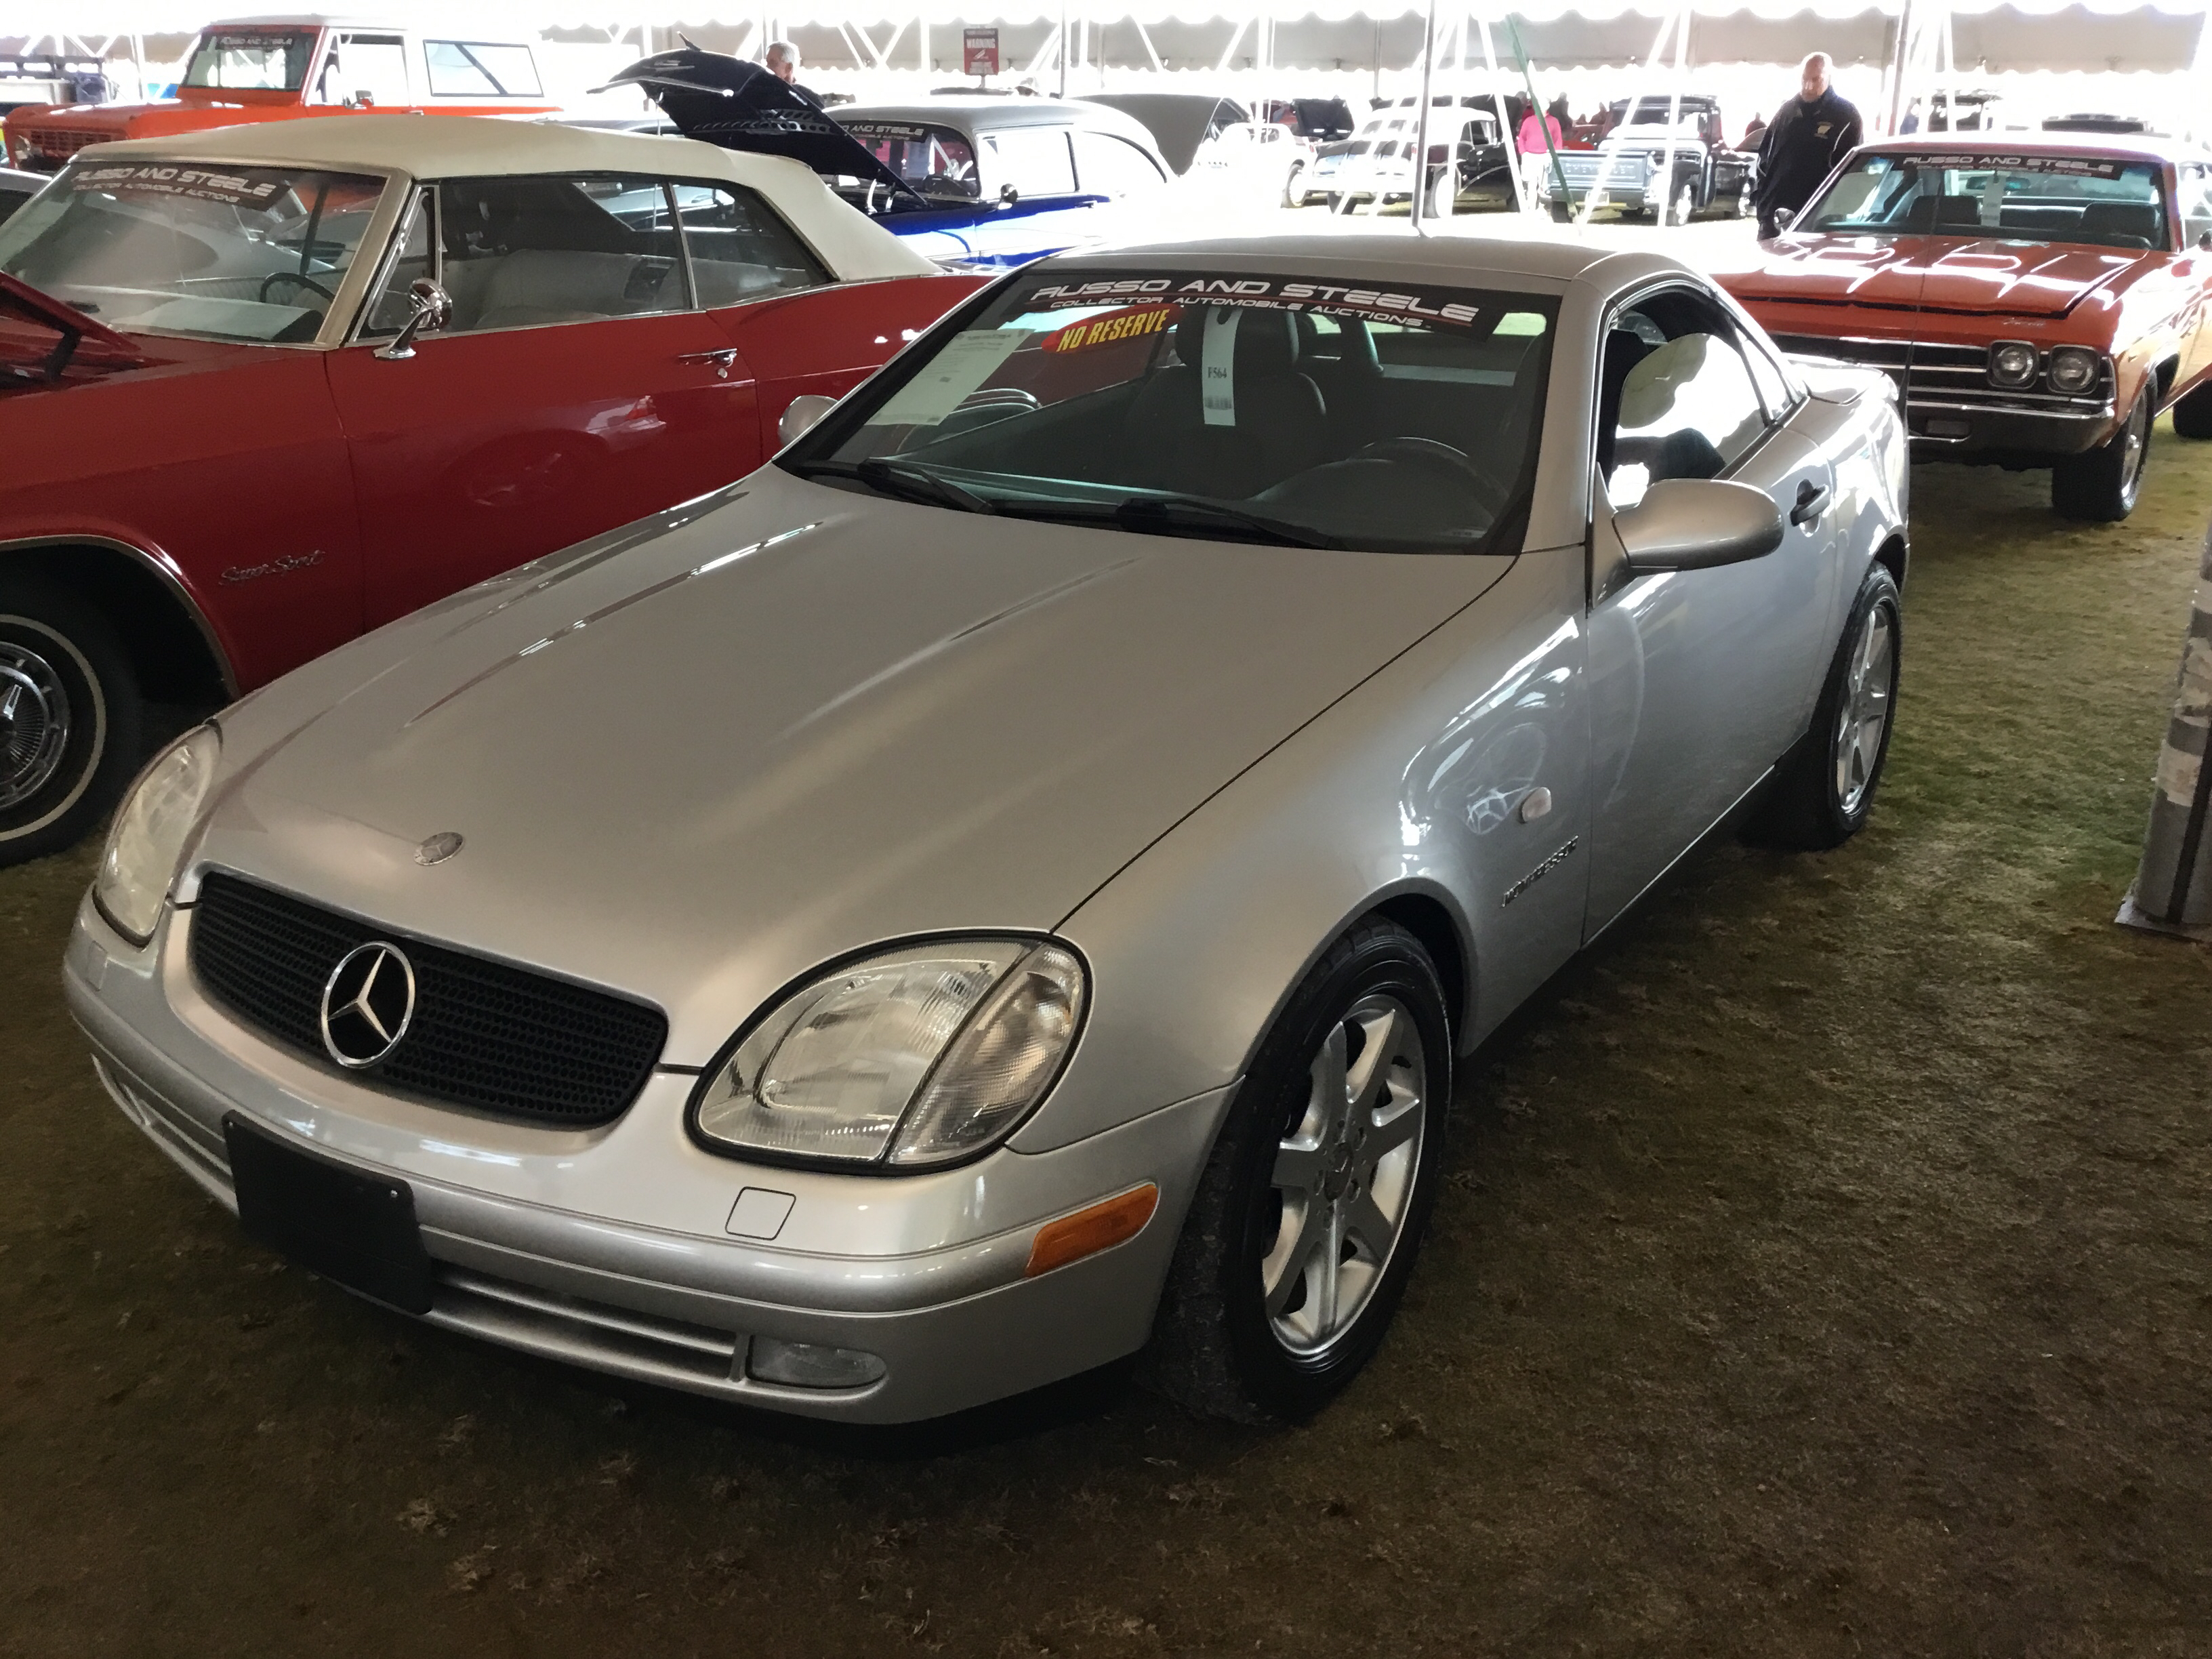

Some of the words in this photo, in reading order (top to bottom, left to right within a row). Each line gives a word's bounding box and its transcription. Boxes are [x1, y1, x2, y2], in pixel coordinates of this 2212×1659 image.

[876, 125, 924, 136] STEELE
[1903, 156, 1973, 165] RUSSO
[1978, 157, 2022, 165] AND
[2026, 158, 2114, 173] STEELE
[70, 167, 136, 182] RUSSO
[134, 167, 178, 181] AND
[177, 170, 276, 197] STEELE
[1030, 279, 1172, 301] RUSSO
[1177, 279, 1271, 294] AND
[1279, 283, 1480, 323] STEELE
[1050, 296, 1164, 308] COLLECTOR
[1172, 297, 1304, 311] AUTOMOBILE
[1309, 305, 1425, 327] AUCTIONS
[1055, 326, 1086, 353] NO
[1085, 308, 1170, 346] RESERVE
